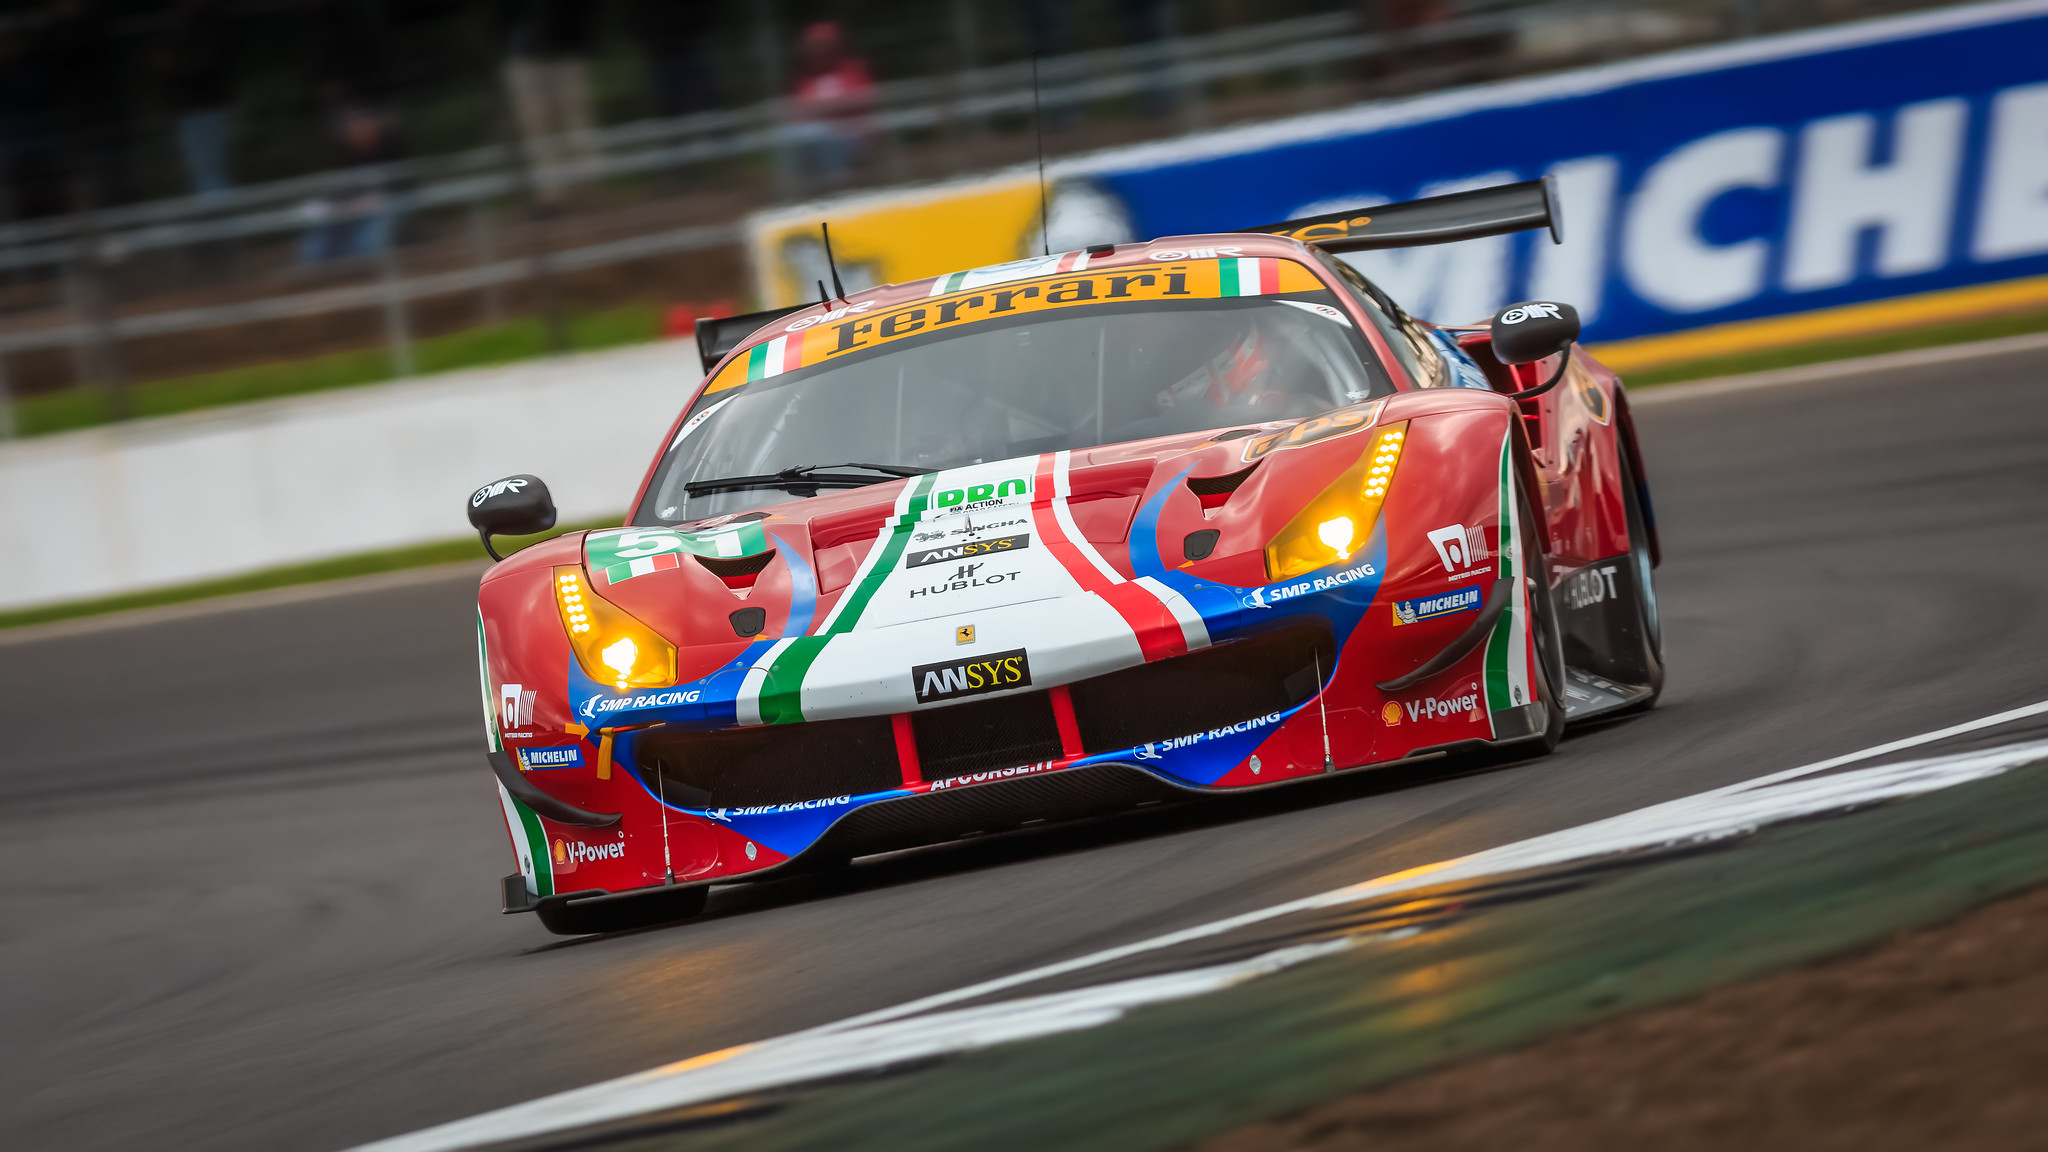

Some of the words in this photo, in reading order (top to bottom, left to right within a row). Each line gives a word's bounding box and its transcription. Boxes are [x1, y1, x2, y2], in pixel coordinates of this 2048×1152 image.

[826, 266, 1191, 356] Ferrari
[965, 498, 1004, 511] ACTION
[909, 571, 1022, 599] HUBLOT
[1270, 582, 1311, 601] SMP
[1313, 563, 1376, 591] RACING
[1418, 589, 1479, 615] MICHELIN
[596, 698, 632, 712] SMP
[632, 690, 700, 709] RACING
[1405, 692, 1478, 723] V-Power
[1162, 732, 1205, 752] SMP
[1208, 711, 1281, 740] RACING
[530, 749, 578, 764] MICHELIN
[732, 803, 777, 816] SMP
[778, 794, 851, 812] RACING
[565, 840, 626, 864] V-Power
